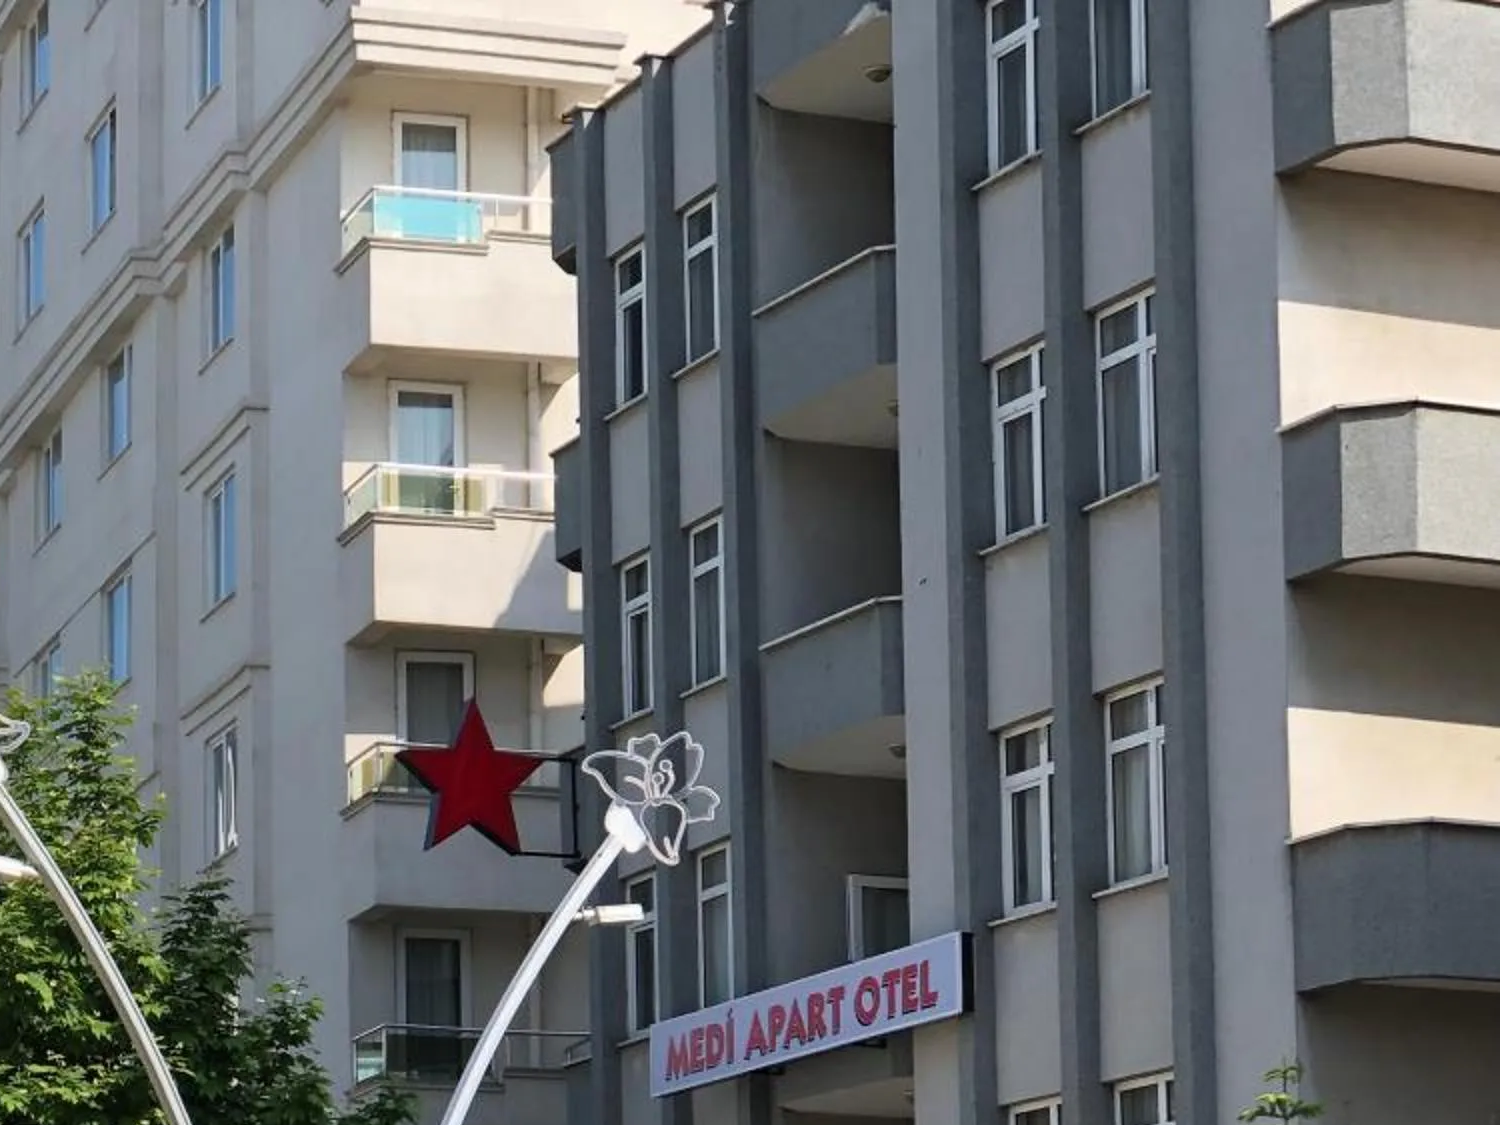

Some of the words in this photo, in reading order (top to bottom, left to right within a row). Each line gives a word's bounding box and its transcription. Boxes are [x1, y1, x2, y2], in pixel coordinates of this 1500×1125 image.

[665, 1007, 736, 1081] MEDİ
[743, 986, 846, 1060] APART
[854, 959, 939, 1026] OTEL
